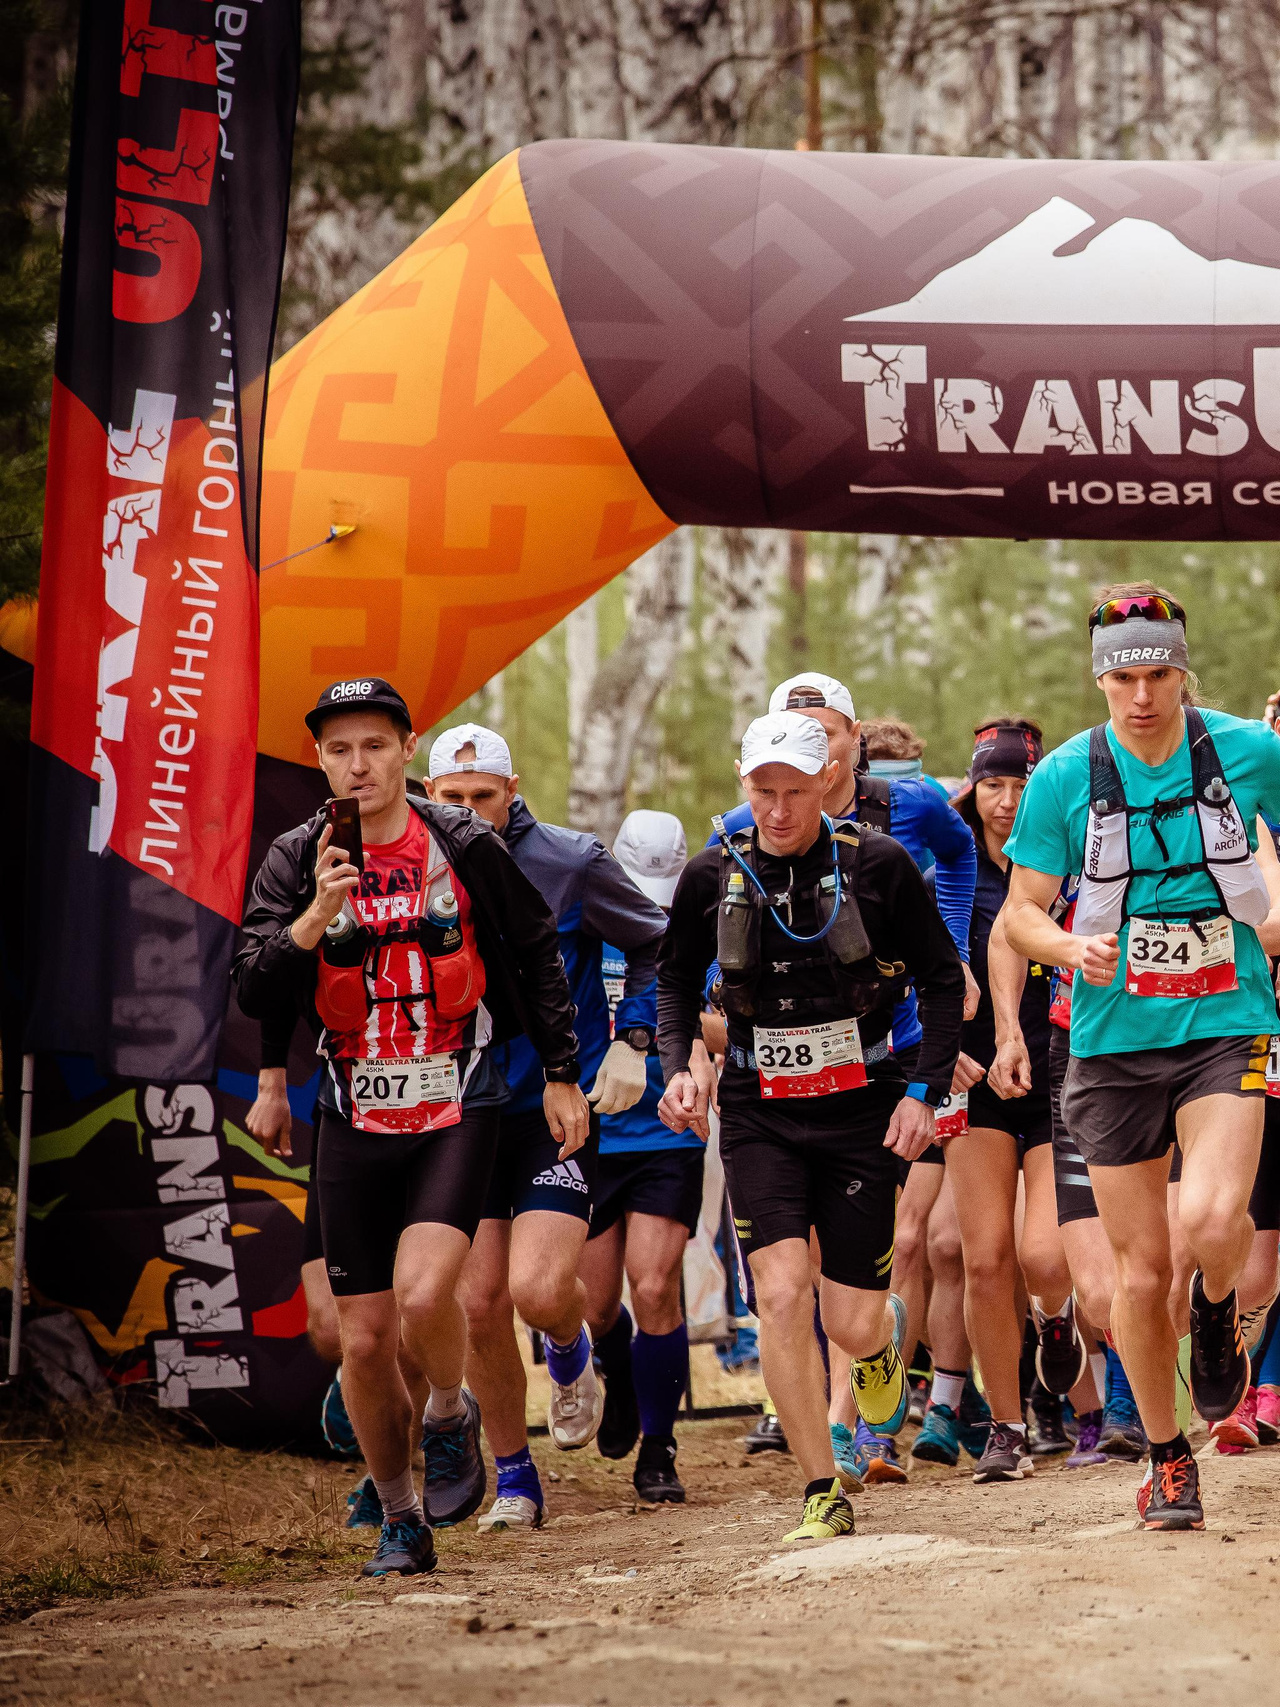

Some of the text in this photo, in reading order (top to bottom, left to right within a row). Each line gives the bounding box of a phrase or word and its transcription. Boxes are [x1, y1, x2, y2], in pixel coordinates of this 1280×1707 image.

[1111, 647, 1173, 664] TERREX
[1089, 834, 1103, 878] TERREX
[1168, 925, 1194, 933] ULTRA
[1131, 937, 1191, 965] 324
[810, 1025, 832, 1034] TRAIL
[365, 1059, 385, 1067] URAL
[385, 1058, 410, 1066] ULTRA
[758, 1044, 813, 1067] 328
[355, 1074, 409, 1100] 207
[532, 1174, 589, 1194] adidas
